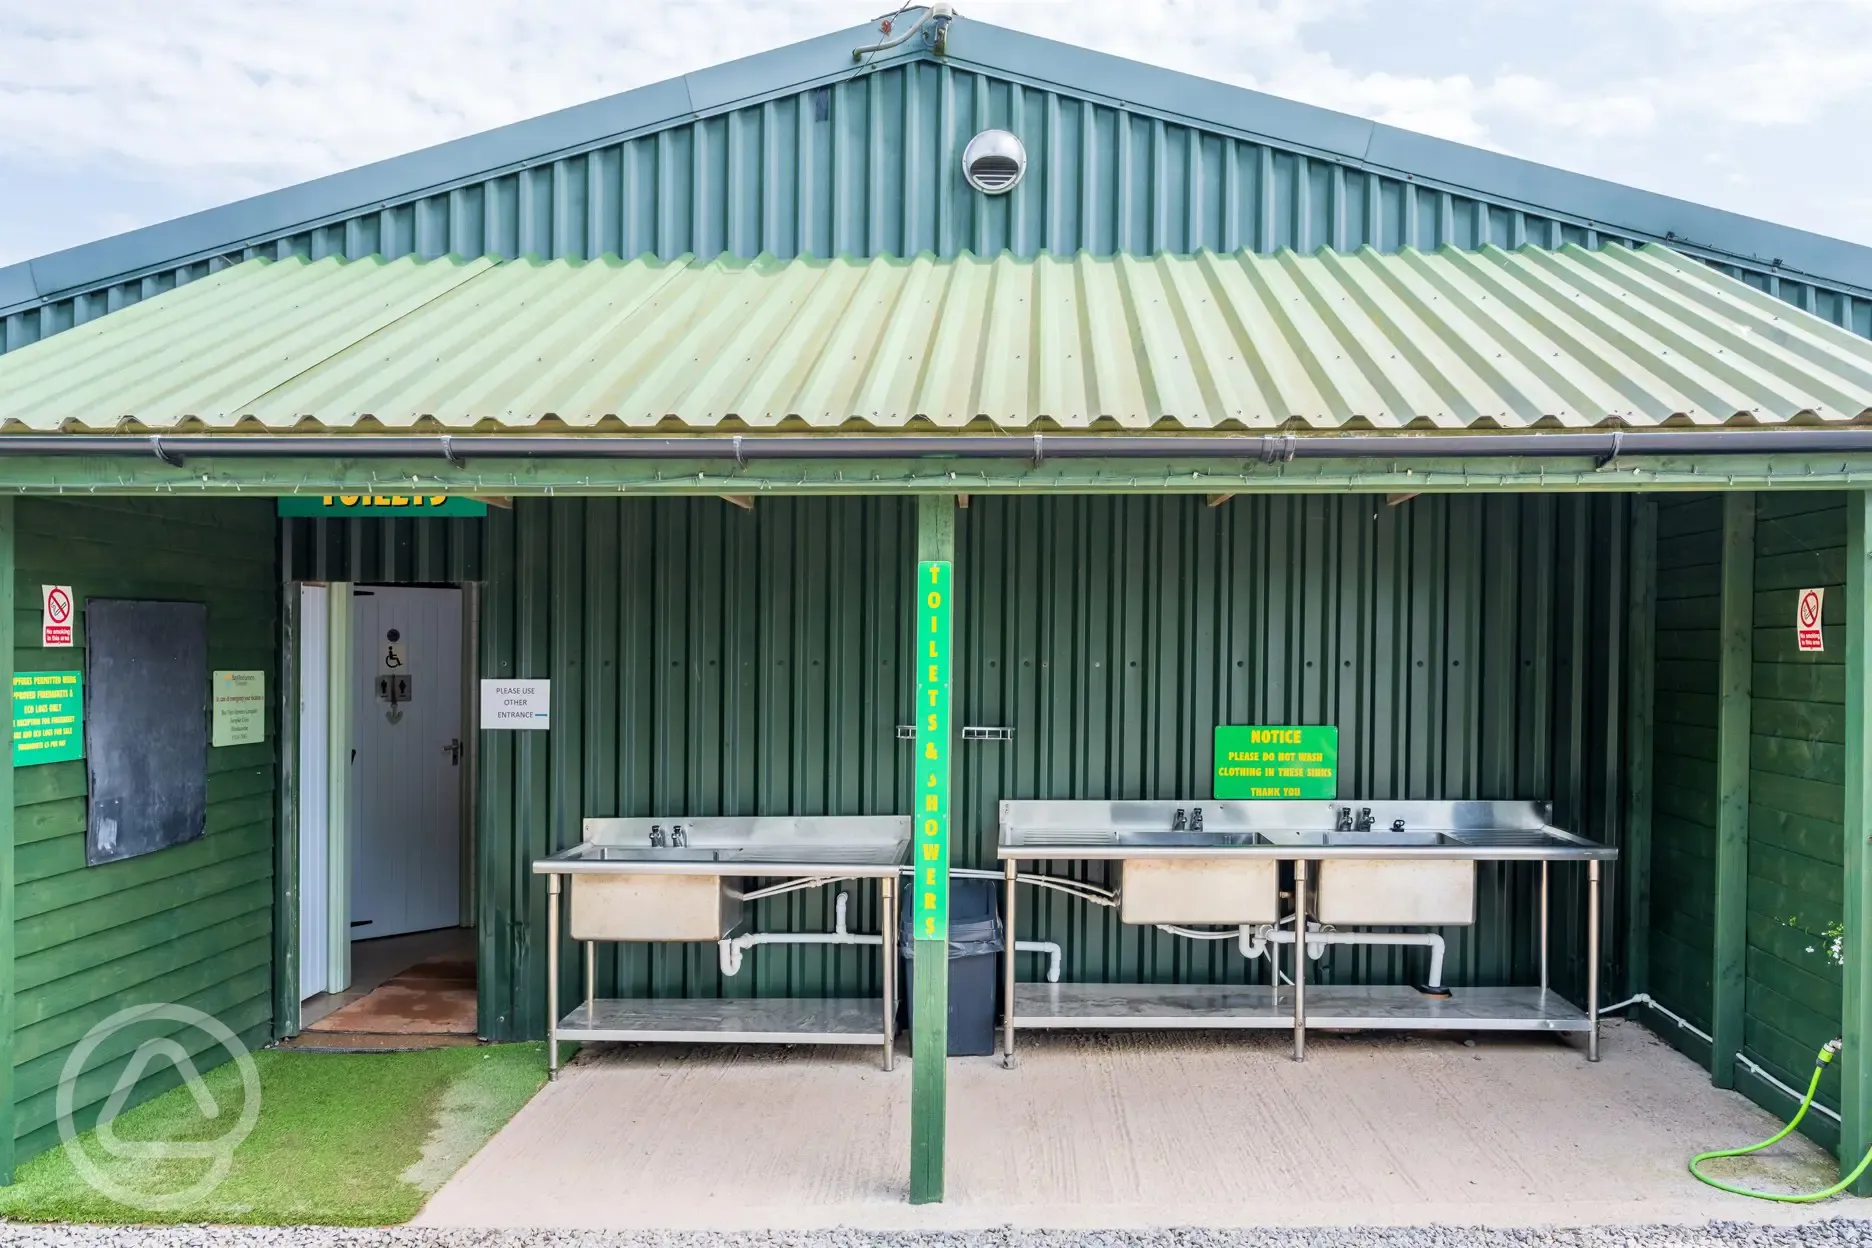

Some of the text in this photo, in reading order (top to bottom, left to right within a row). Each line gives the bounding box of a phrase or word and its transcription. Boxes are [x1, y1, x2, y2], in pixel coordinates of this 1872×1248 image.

[33, 676, 61, 685] PERMITTED
[496, 687, 535, 695] PLEASE USE
[24, 705, 34, 714] ECO
[16, 718, 41, 727] RECEPTION
[1250, 730, 1302, 744] NOTICE
[922, 567, 942, 935] TOILETS & SHOWERS
[1228, 752, 1323, 762] PLEASE DO NOT WASH
[1218, 767, 1332, 777] CLOTHING IN THESE SINKS
[1250, 787, 1301, 797] THANK YOU
